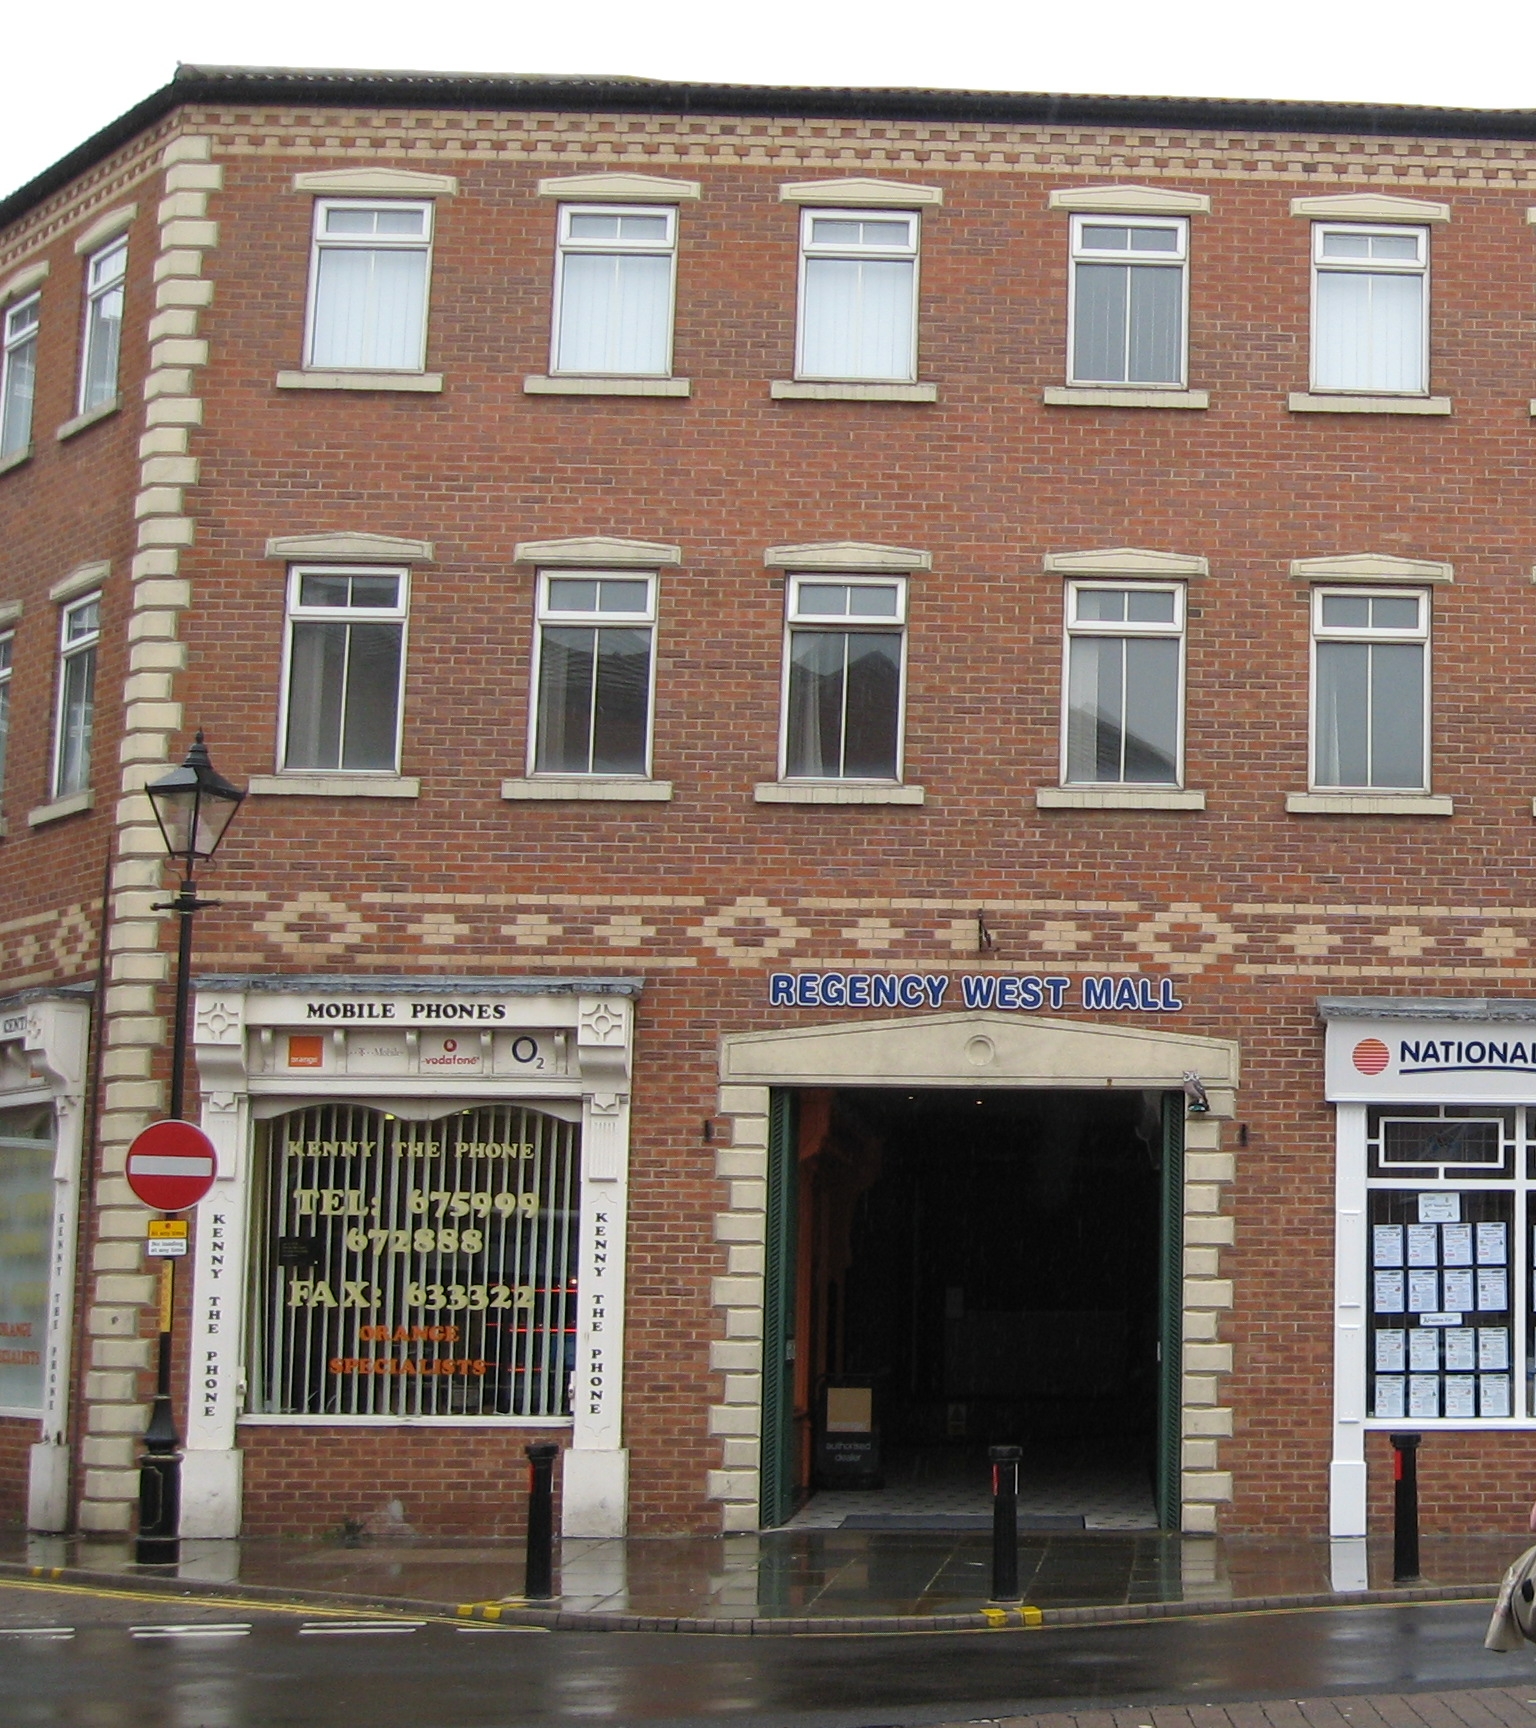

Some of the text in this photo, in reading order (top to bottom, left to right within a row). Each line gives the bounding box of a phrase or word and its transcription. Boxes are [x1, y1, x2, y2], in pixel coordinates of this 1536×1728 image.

[768, 972, 1183, 1012] REGENCY WEST MALL
[306, 1003, 506, 1019] MOBILE PHONES
[425, 1055, 477, 1065] vodafone
[512, 1036, 545, 1070] O2
[288, 1141, 535, 1159] KENNY THE PHONE
[293, 1188, 540, 1218] TEL: 675999
[346, 1227, 483, 1256] 672888
[287, 1280, 535, 1311] FAX: 633322
[204, 1214, 226, 1417] KENNY THE PHONE
[589, 1213, 608, 1415] KENNY THE PHONE
[359, 1325, 460, 1342] ORANGE
[329, 1358, 487, 1376] SPECIALISTS
